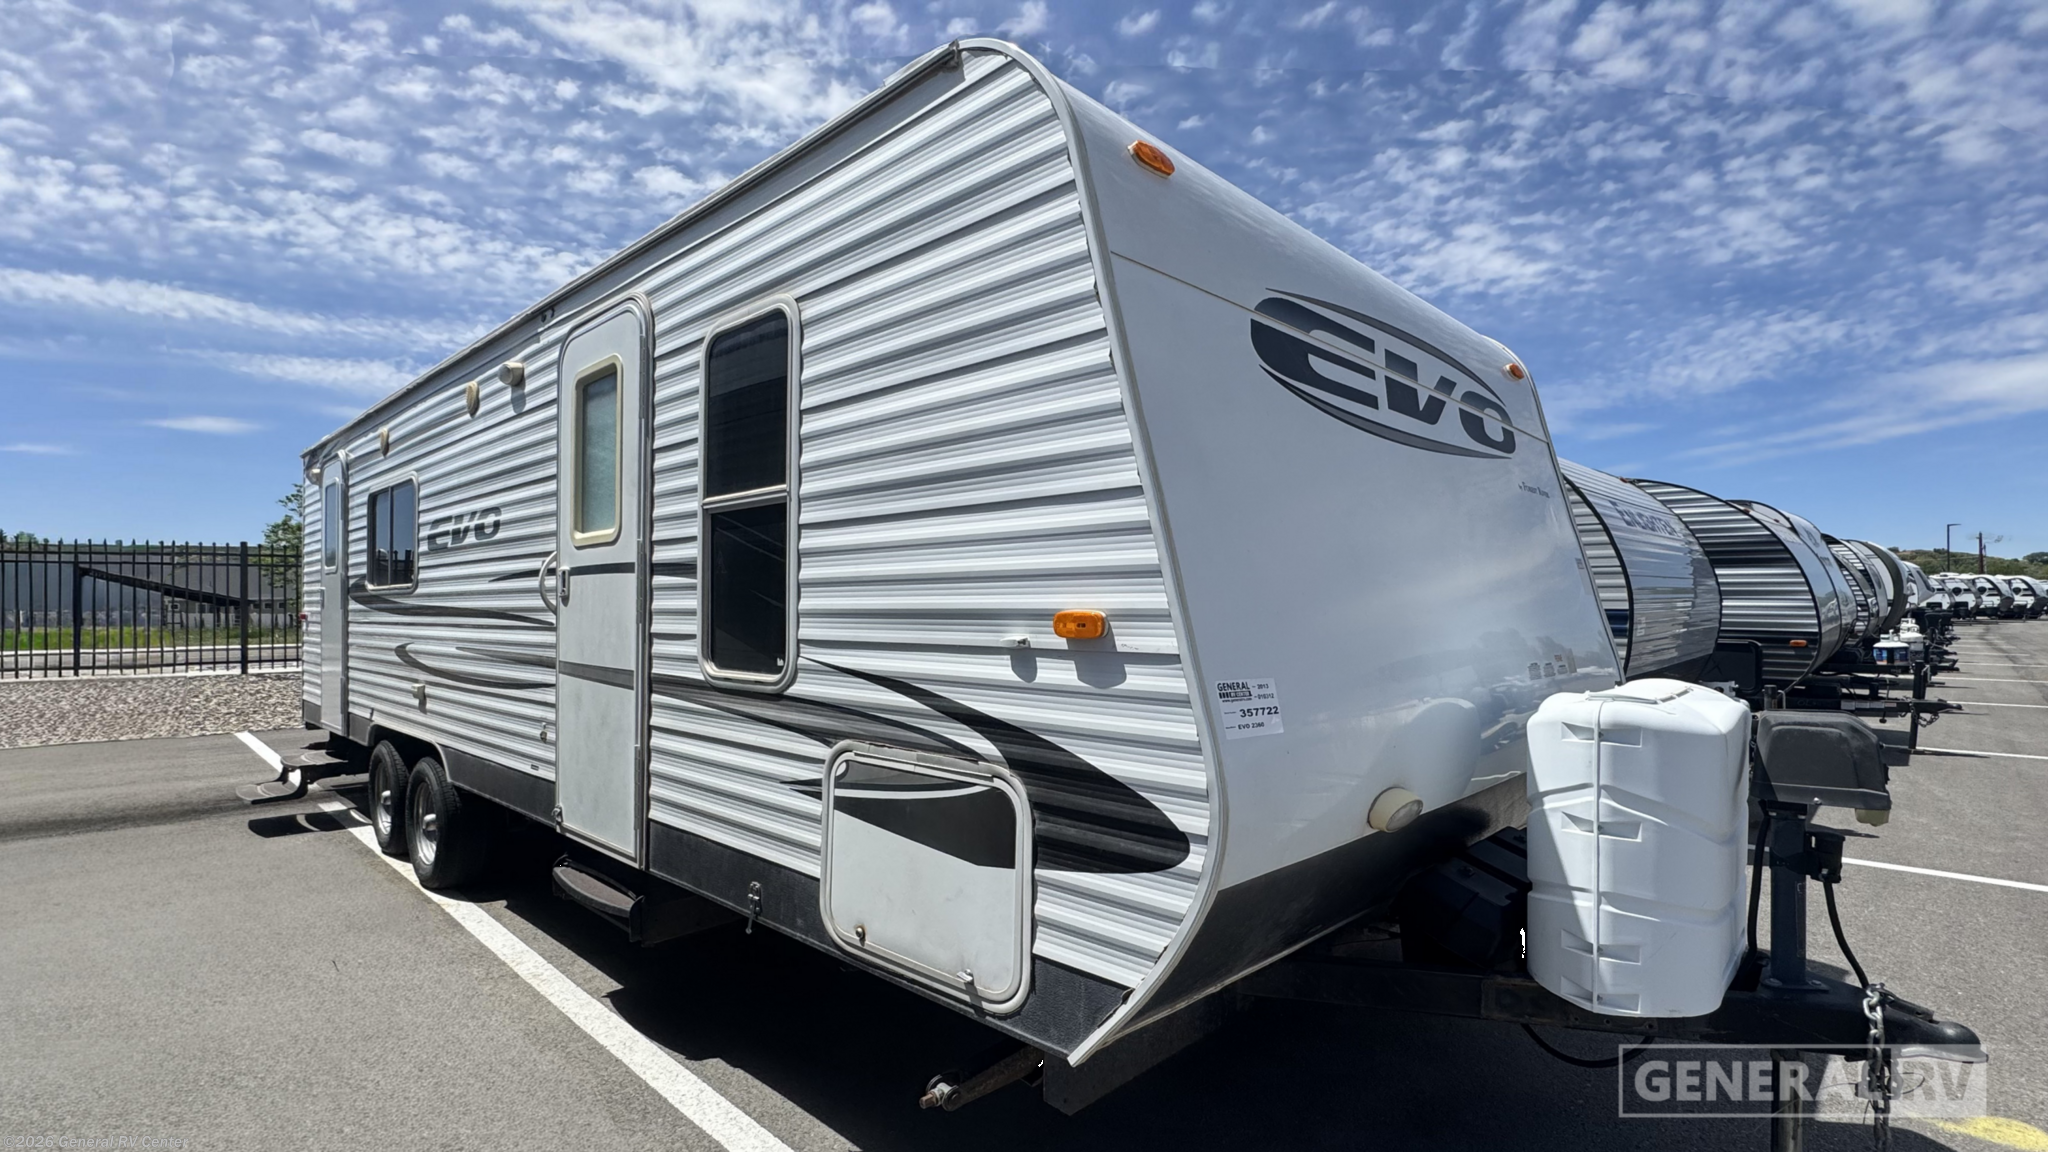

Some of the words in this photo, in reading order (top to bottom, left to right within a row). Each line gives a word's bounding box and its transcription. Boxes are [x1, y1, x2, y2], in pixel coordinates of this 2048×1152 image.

[1250, 297, 1516, 454] EVO
[427, 507, 502, 552] EVO
[1217, 681, 1250, 692] GENERAL
[1239, 706, 1279, 718] 357722
